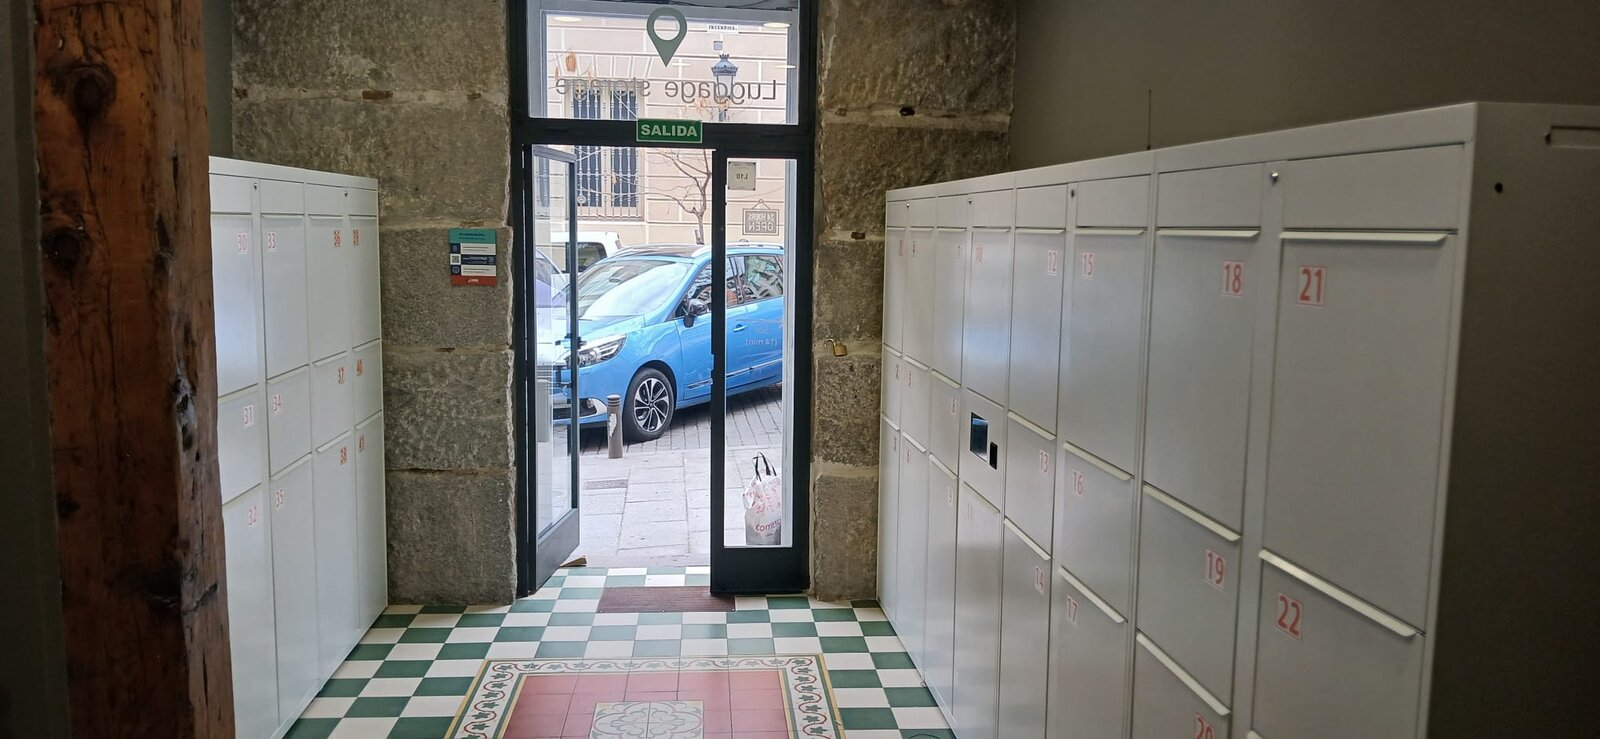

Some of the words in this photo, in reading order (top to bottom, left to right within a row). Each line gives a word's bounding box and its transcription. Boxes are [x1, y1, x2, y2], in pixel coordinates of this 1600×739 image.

[640, 124, 698, 137] SALIDA
[237, 233, 247, 252] 30
[267, 232, 276, 249] 33
[334, 230, 341, 247] 36
[975, 246, 983, 263] 10
[1048, 251, 1057, 272] 12
[1084, 253, 1094, 276] 15
[1223, 263, 1242, 293] 18
[1300, 267, 1323, 303] 21
[338, 367, 344, 384] 37
[273, 393, 282, 412] 34
[244, 405, 253, 425] 31
[1040, 451, 1048, 472] 13
[1073, 470, 1083, 495] 16
[275, 488, 283, 508] 35
[248, 505, 257, 526] 32
[1036, 567, 1043, 590] 14
[1207, 552, 1224, 585] 19
[1067, 598, 1078, 622] 17
[1277, 595, 1300, 637] 22
